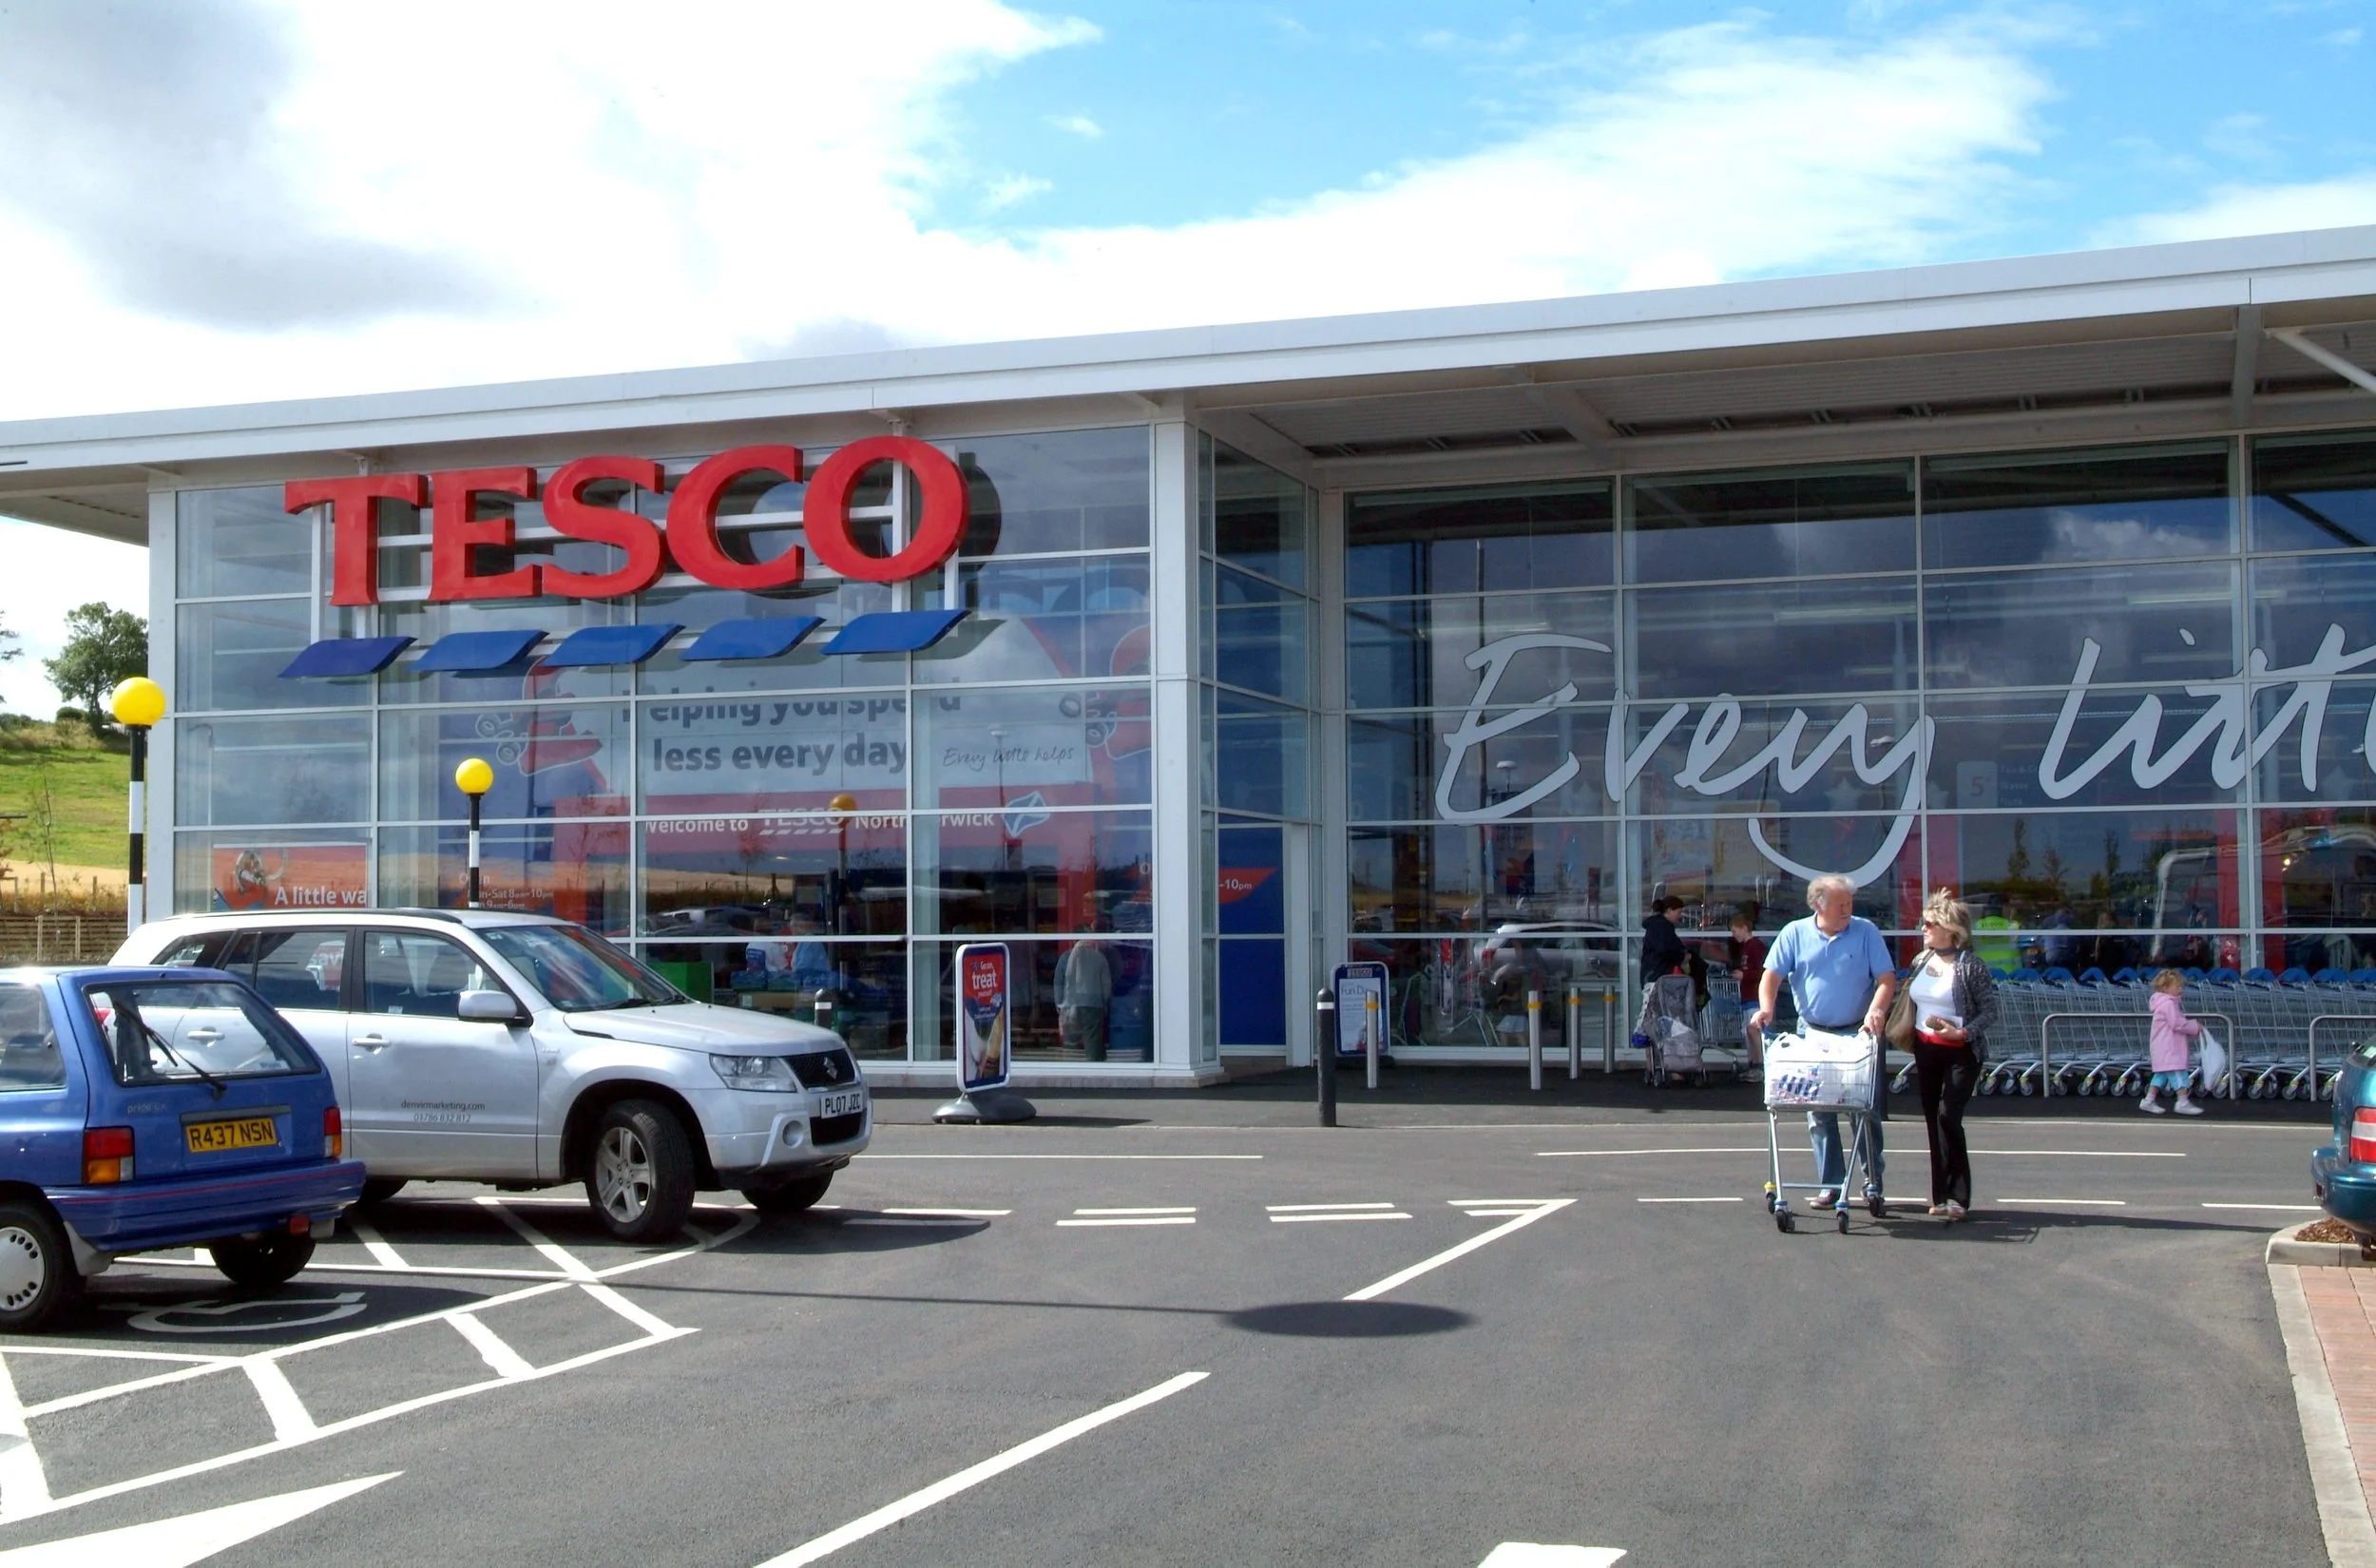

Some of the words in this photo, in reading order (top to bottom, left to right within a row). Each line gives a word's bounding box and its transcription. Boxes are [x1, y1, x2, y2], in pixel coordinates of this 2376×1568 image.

[286, 435, 969, 605] TESCO
[770, 698, 842, 726] you
[847, 677, 961, 721] sped
[653, 738, 722, 771] less
[731, 741, 834, 775] every
[844, 733, 907, 774] day
[943, 747, 986, 772] Every
[1034, 746, 1074, 765] helps
[1434, 633, 1935, 887] Every
[2038, 622, 2376, 799] litt
[729, 818, 749, 832] to
[939, 813, 995, 827] rwick
[275, 886, 289, 905] A
[293, 886, 336, 904] little
[972, 970, 997, 989] treat
[825, 1095, 846, 1114] PL07
[190, 1124, 235, 1149] R437
[240, 1121, 274, 1142] NSN
